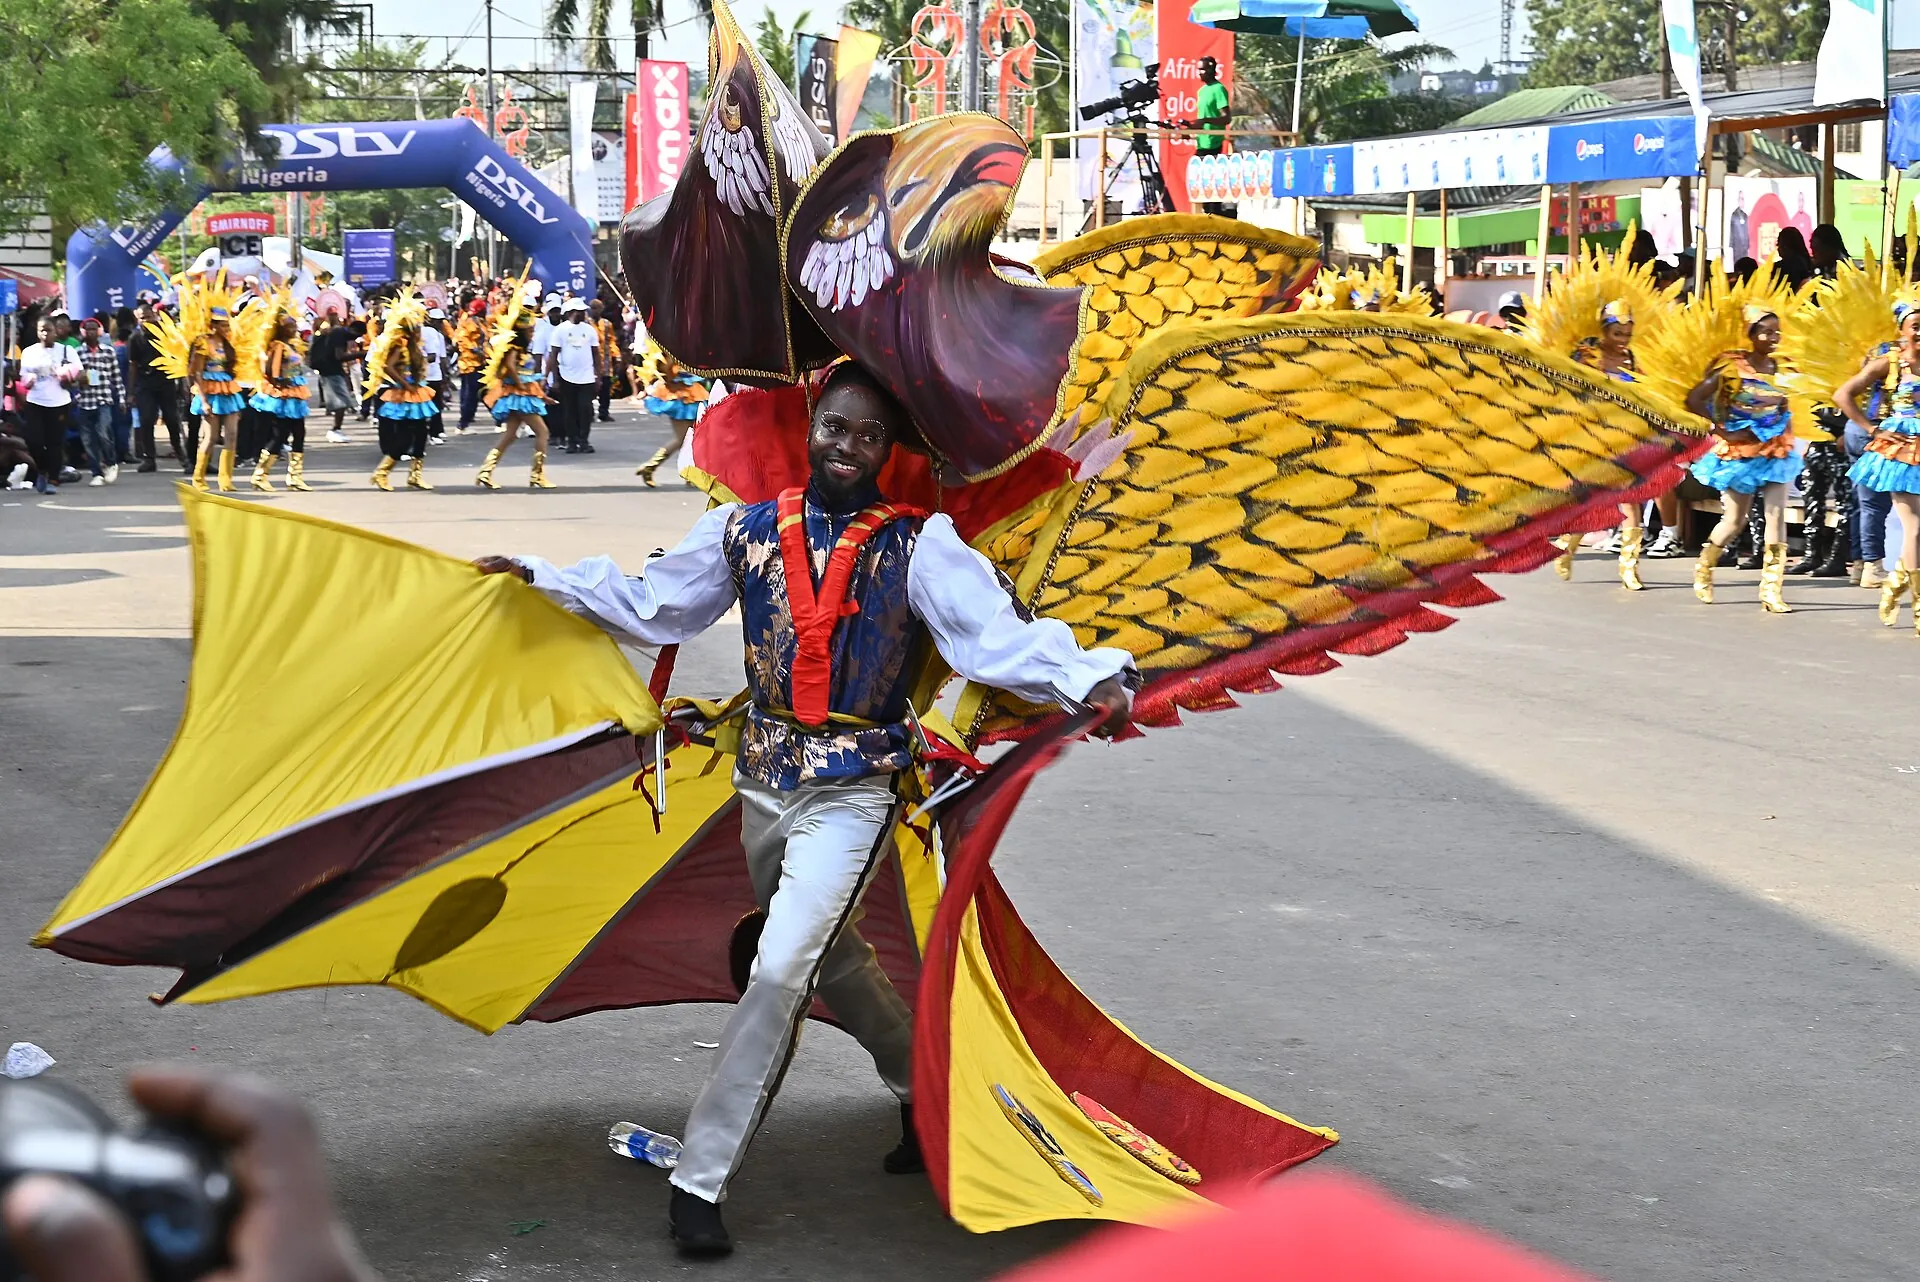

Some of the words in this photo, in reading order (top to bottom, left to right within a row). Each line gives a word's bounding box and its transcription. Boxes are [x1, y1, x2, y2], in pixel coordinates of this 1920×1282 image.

[241, 165, 328, 187] Nigeria
[465, 171, 506, 208] Nigeria
[210, 217, 269, 233] SMIRNOFF
[220, 235, 260, 256] ICE
